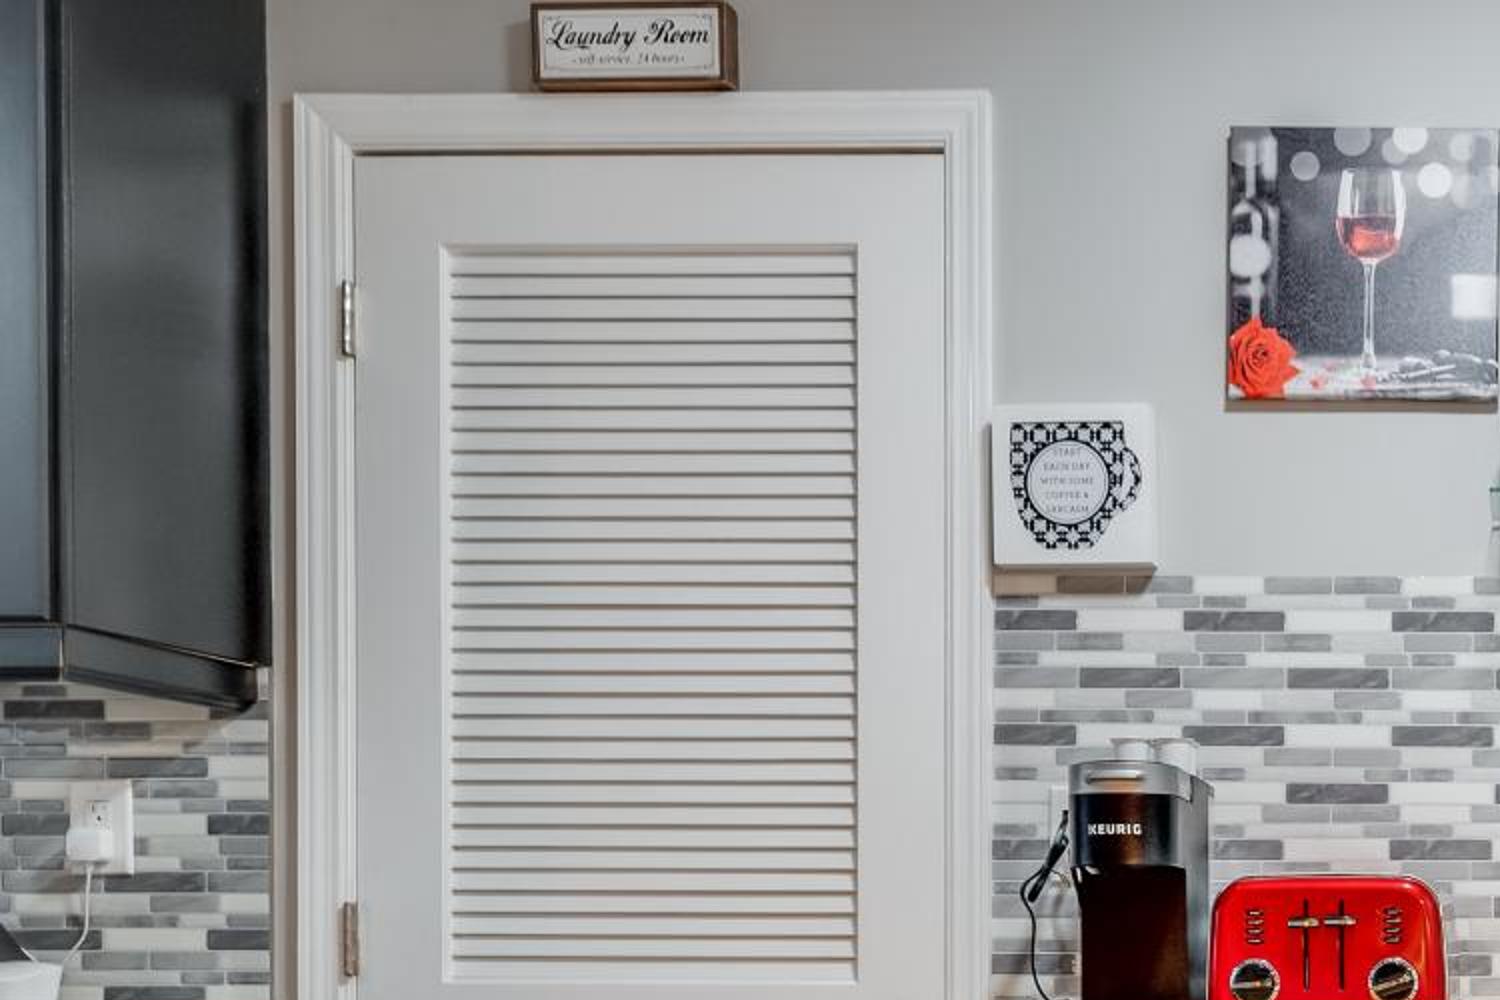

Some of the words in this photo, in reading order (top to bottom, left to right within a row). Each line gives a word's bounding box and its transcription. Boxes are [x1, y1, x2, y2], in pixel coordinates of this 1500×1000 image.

[546, 21, 637, 50] Laundry
[645, 19, 709, 44] Room
[1088, 823, 1143, 835] KEURIG
